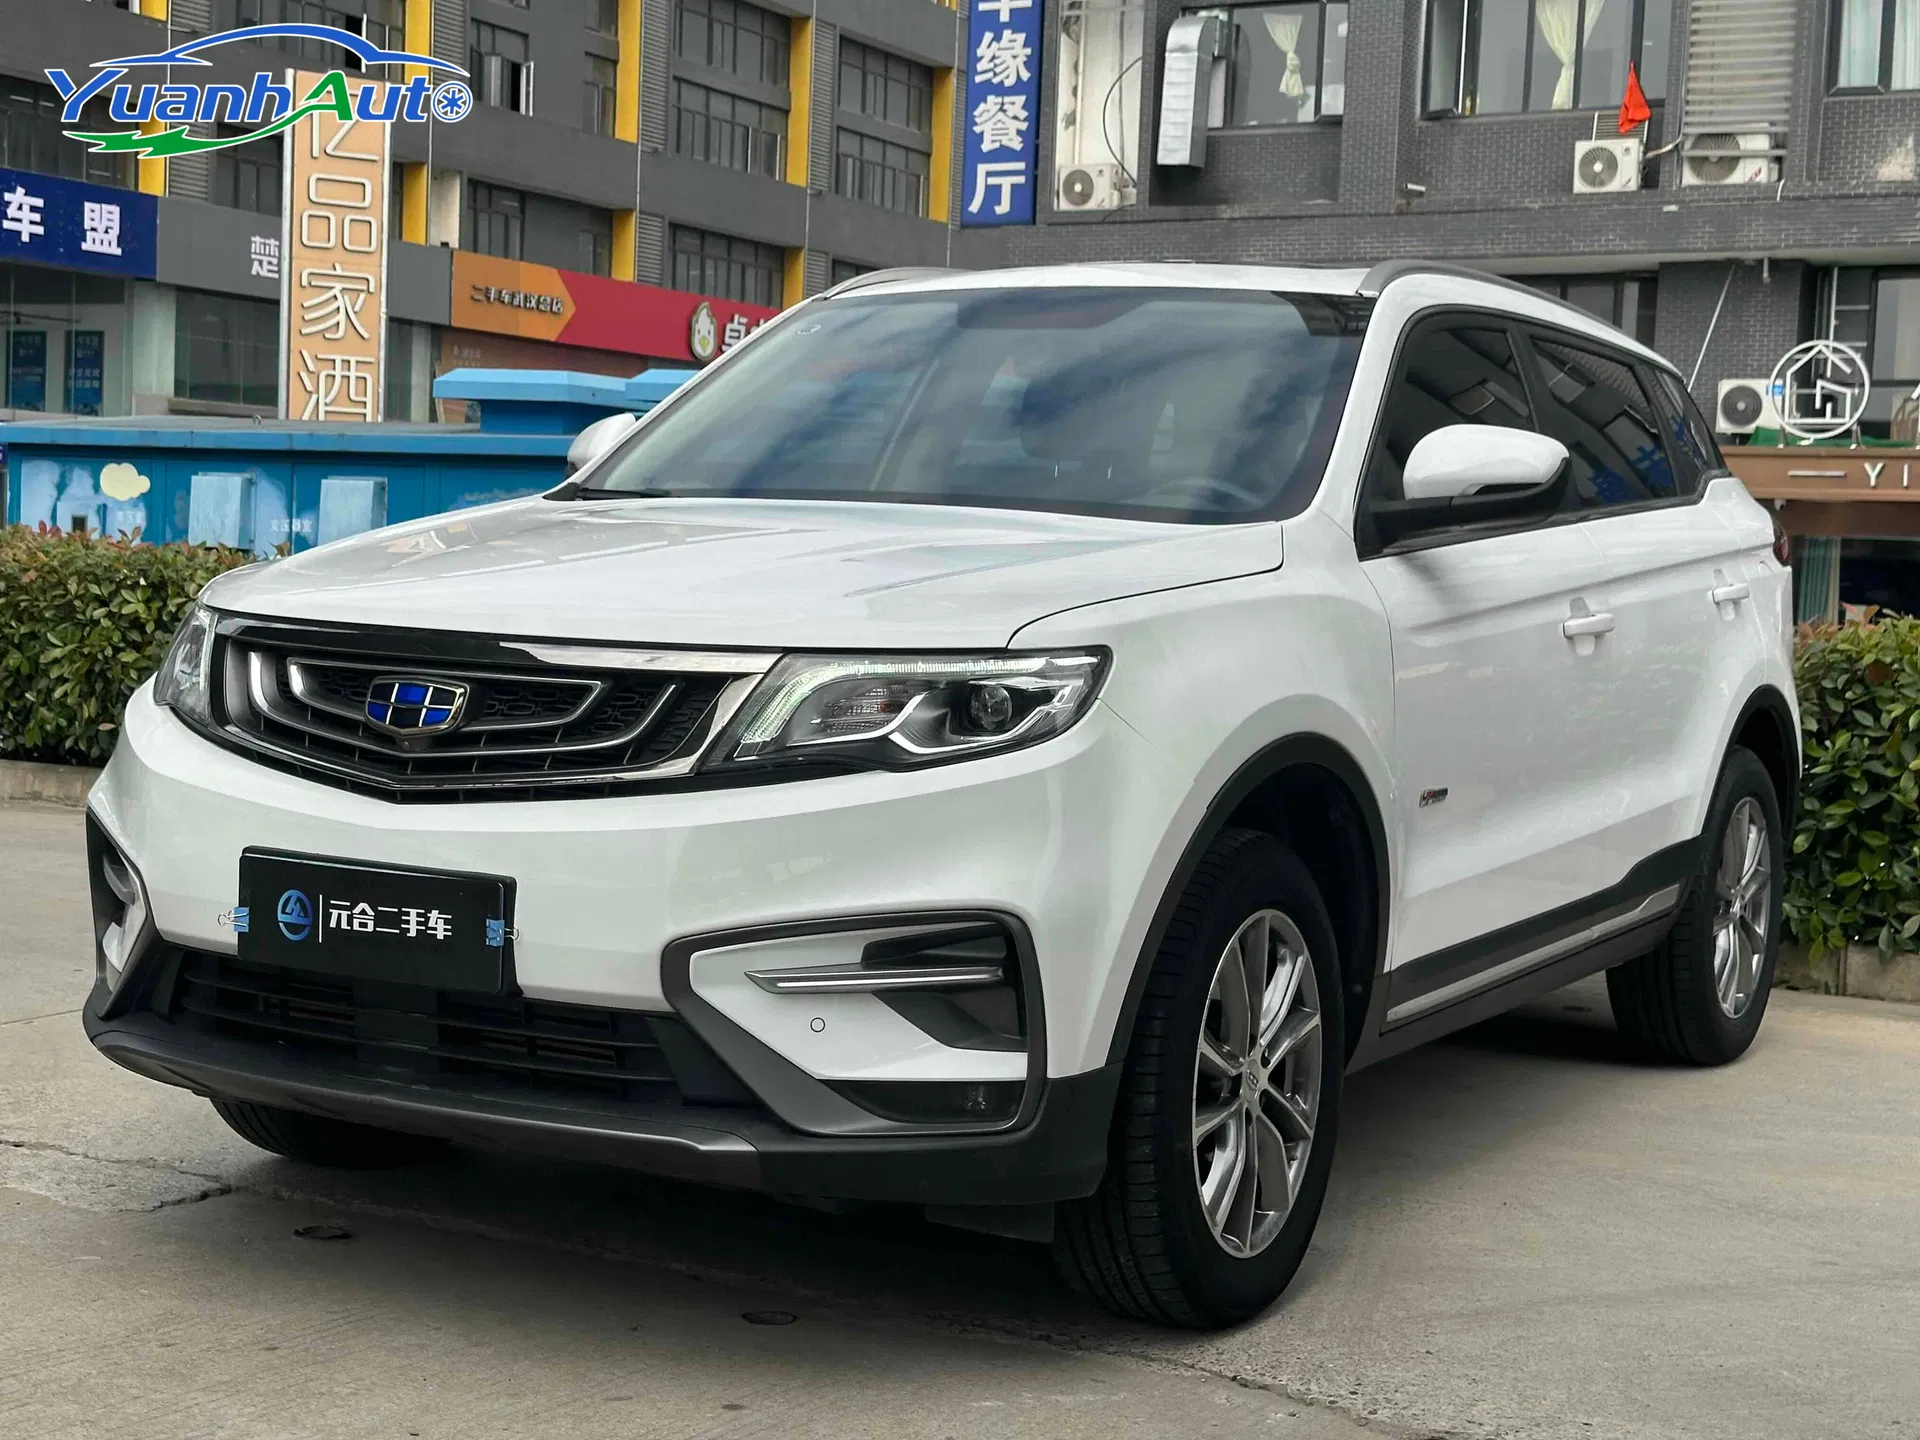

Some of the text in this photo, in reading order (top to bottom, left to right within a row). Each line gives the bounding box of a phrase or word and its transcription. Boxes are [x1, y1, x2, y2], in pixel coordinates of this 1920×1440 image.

[250, 234, 279, 279] 楚
[329, 899, 452, 940] 元合二手车
